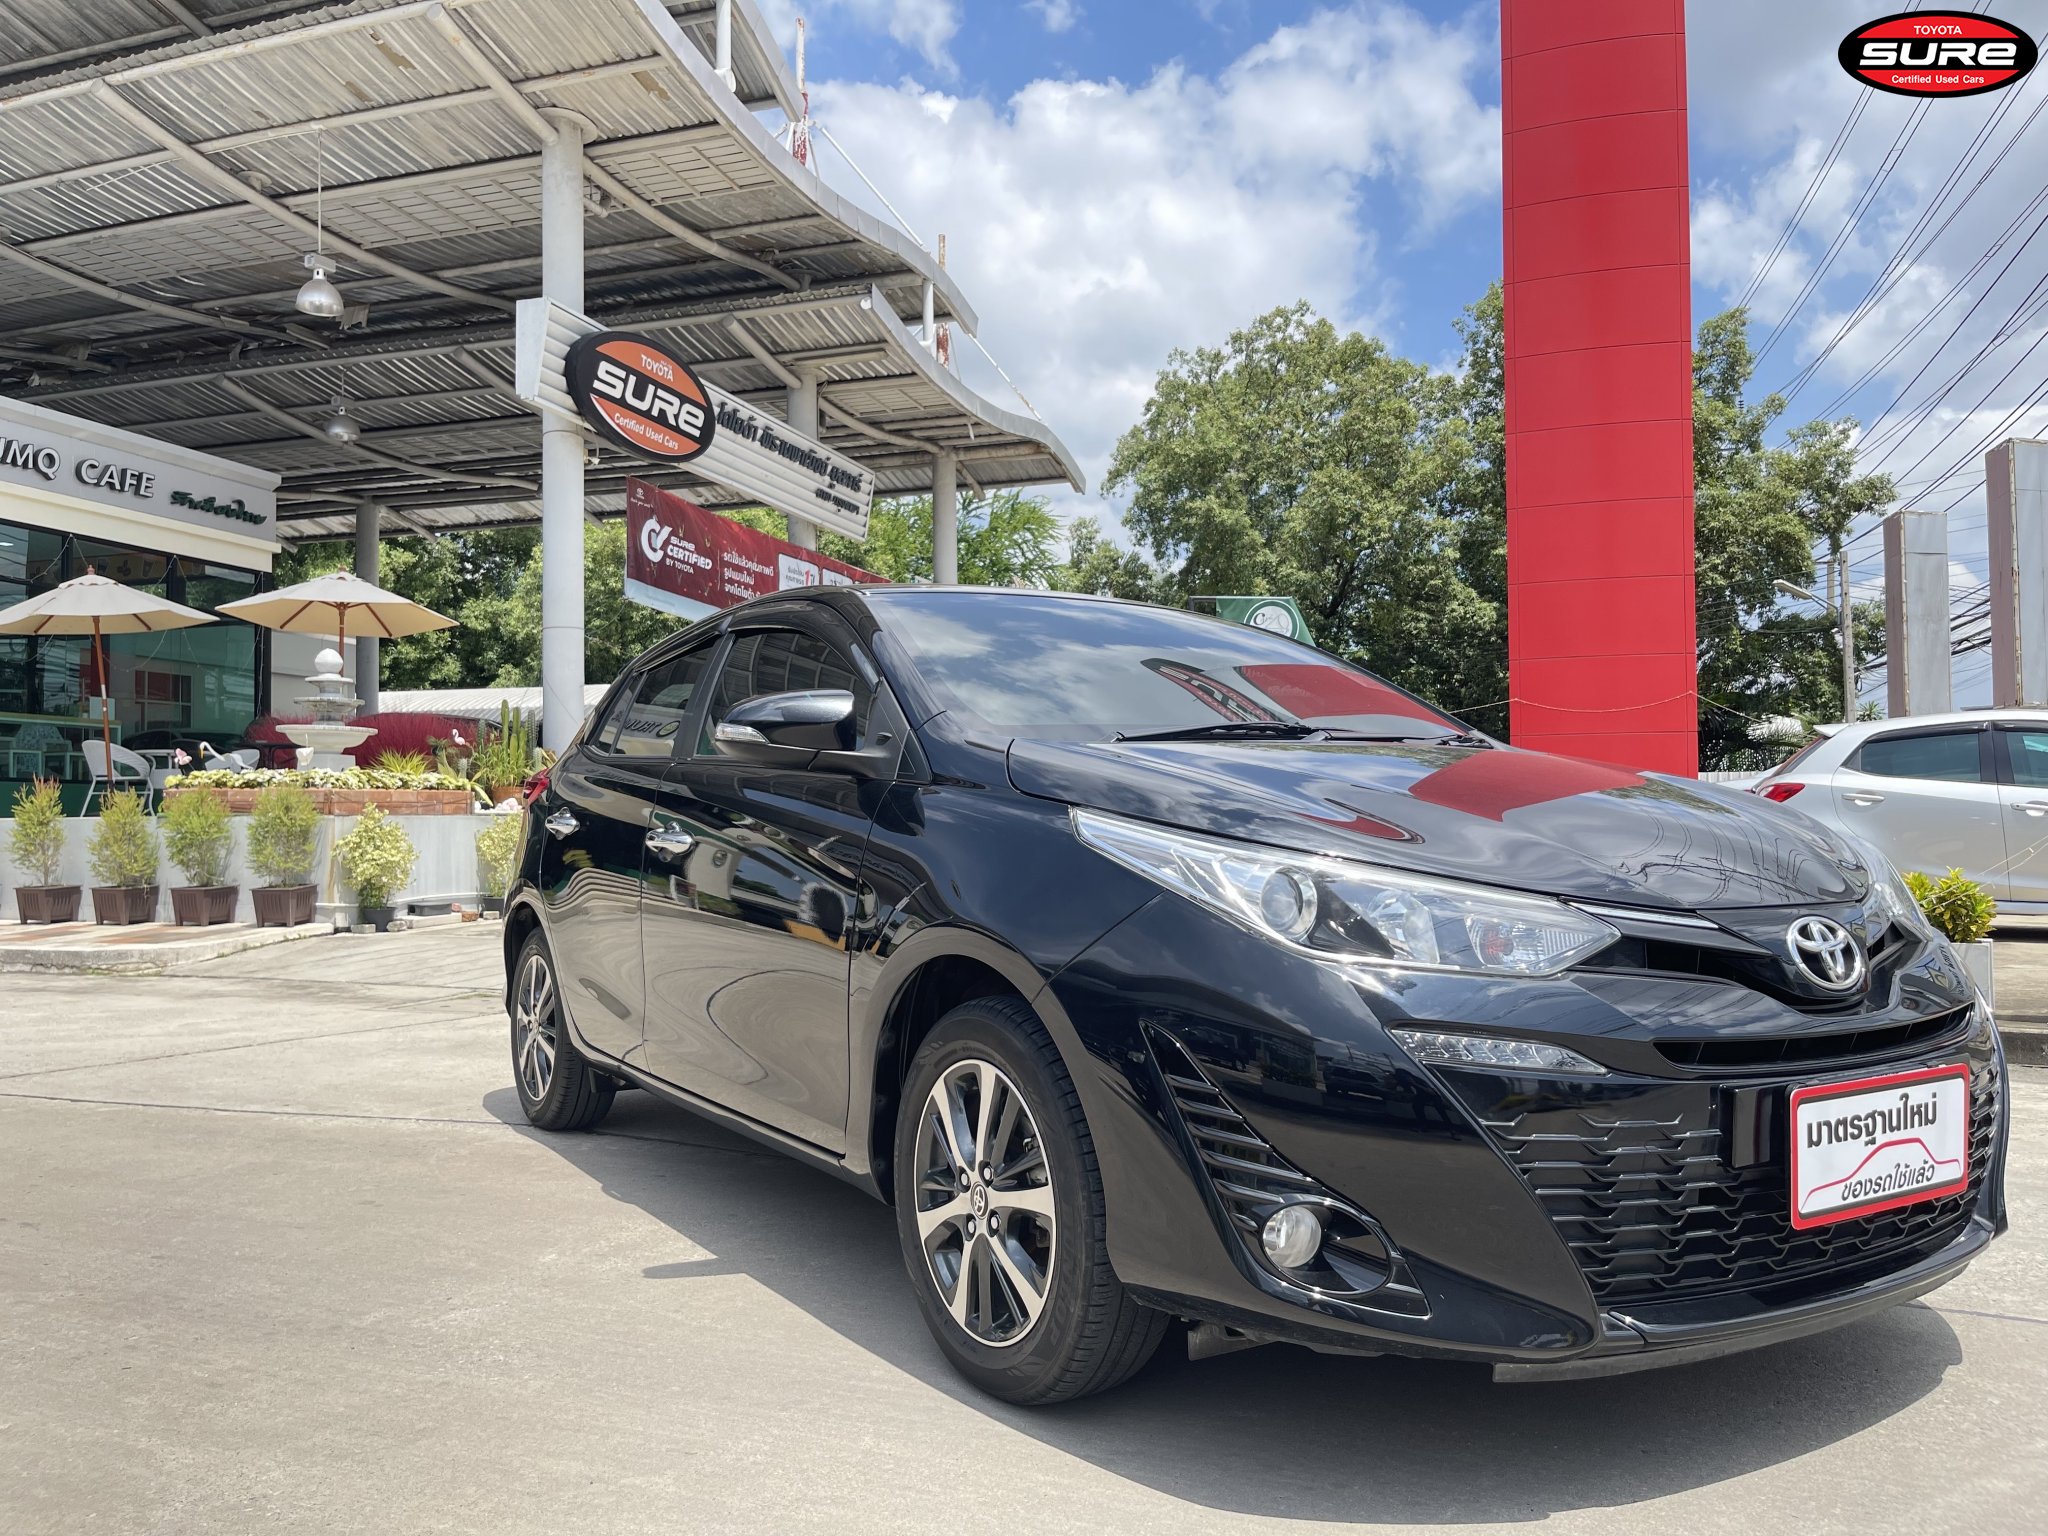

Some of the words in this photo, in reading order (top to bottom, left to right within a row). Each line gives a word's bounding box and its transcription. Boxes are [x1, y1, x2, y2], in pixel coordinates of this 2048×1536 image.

[641, 353, 674, 382] TOYOTA
[614, 412, 645, 435] Certified
[645, 425, 663, 444] Used
[664, 436, 679, 450] Cars
[75, 458, 156, 498] CAFE
[665, 557, 674, 567] BY
[674, 560, 694, 574] TOYOTA
[667, 545, 713, 570] CERTIFIED
[1806, 1091, 1938, 1149] มาตรฐานใหม่
[1841, 1158, 1936, 1202] ของรถใช้แล้ว
